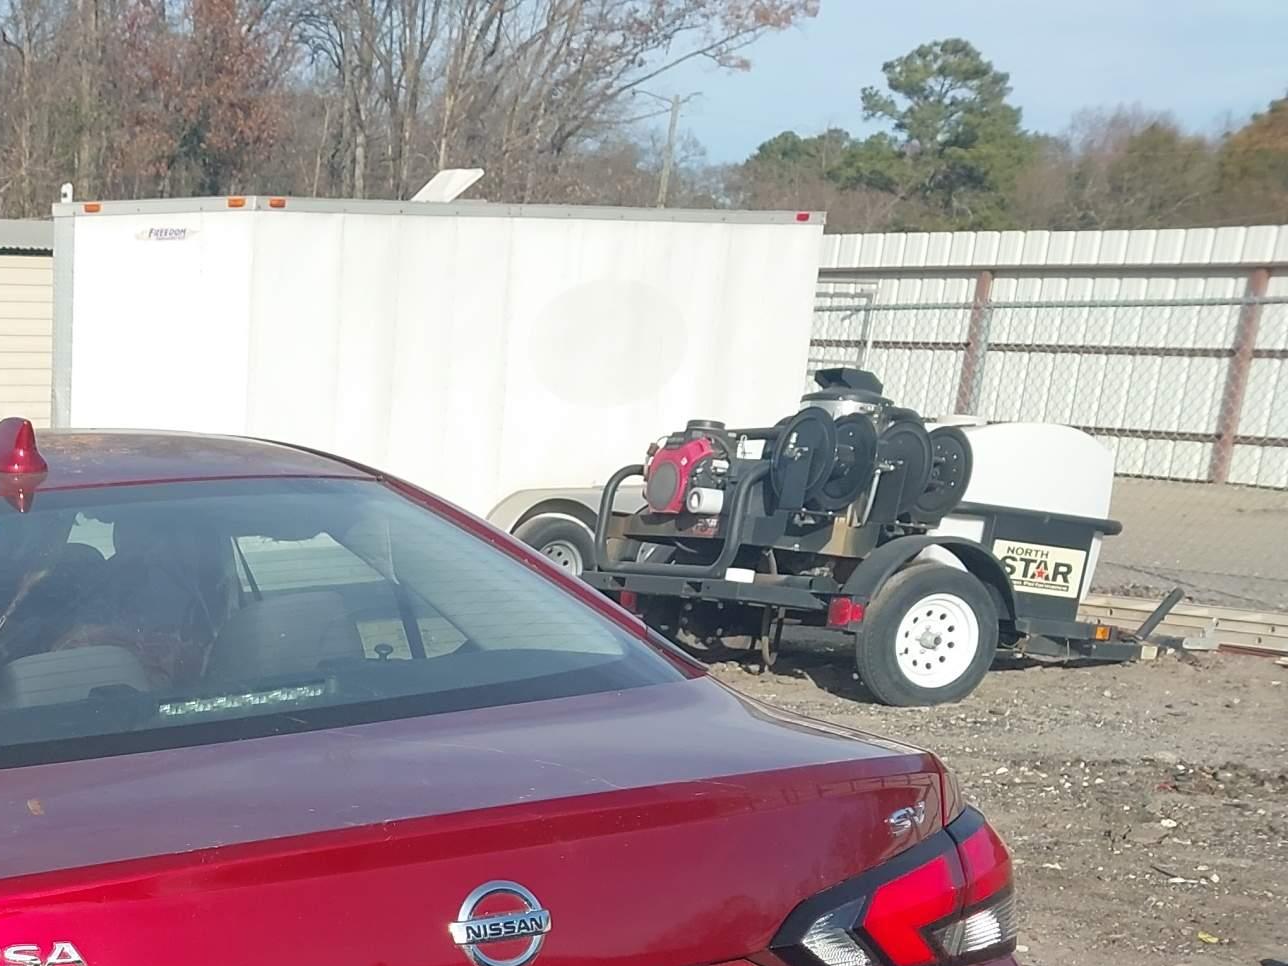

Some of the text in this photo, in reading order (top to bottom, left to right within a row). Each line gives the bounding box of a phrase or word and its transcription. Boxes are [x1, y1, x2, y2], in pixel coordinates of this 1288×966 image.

[147, 228, 187, 239] FREEDOM
[1006, 545, 1050, 560] NORTH
[1000, 555, 1073, 584] STAR
[465, 915, 544, 940] NISSAN
